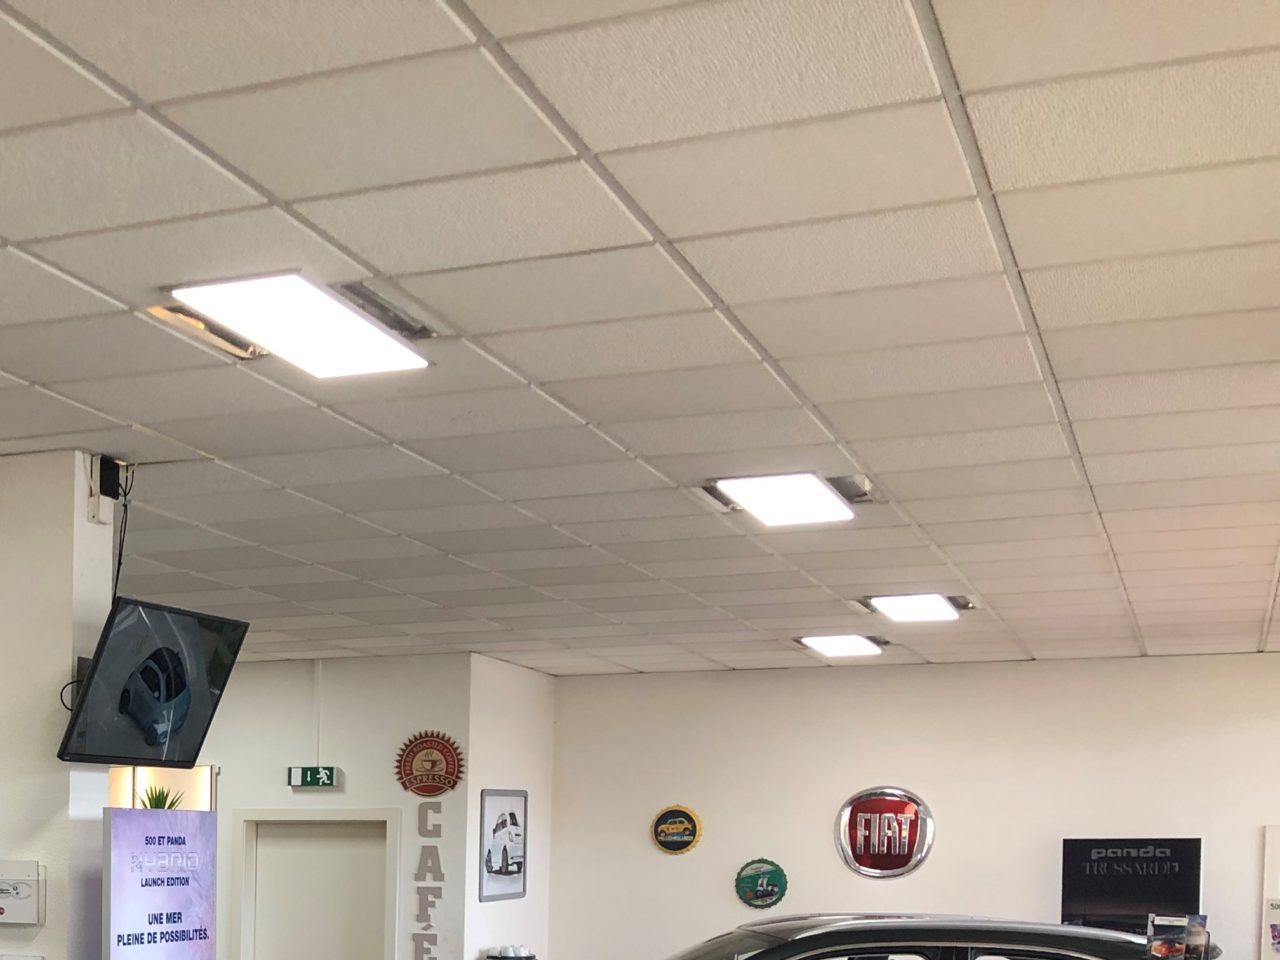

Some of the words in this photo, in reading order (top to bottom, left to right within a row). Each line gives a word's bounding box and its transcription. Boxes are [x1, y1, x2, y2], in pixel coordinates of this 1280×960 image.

[404, 774, 454, 788] ESPRESSO
[856, 812, 916, 855] FIAT
[145, 836, 156, 846] 500
[157, 836, 165, 846] ET
[166, 836, 186, 846] PANDA
[1091, 846, 1171, 860] panda
[1082, 862, 1171, 875] TRUSSARDI
[141, 878, 165, 888] LAUNCH
[166, 876, 190, 887] EDITION
[148, 913, 164, 925] UNE
[165, 911, 183, 924] MER
[117, 932, 145, 947] PLEINE
[147, 932, 158, 945] DE
[160, 925, 209, 943] POSSIBILITÉS.
